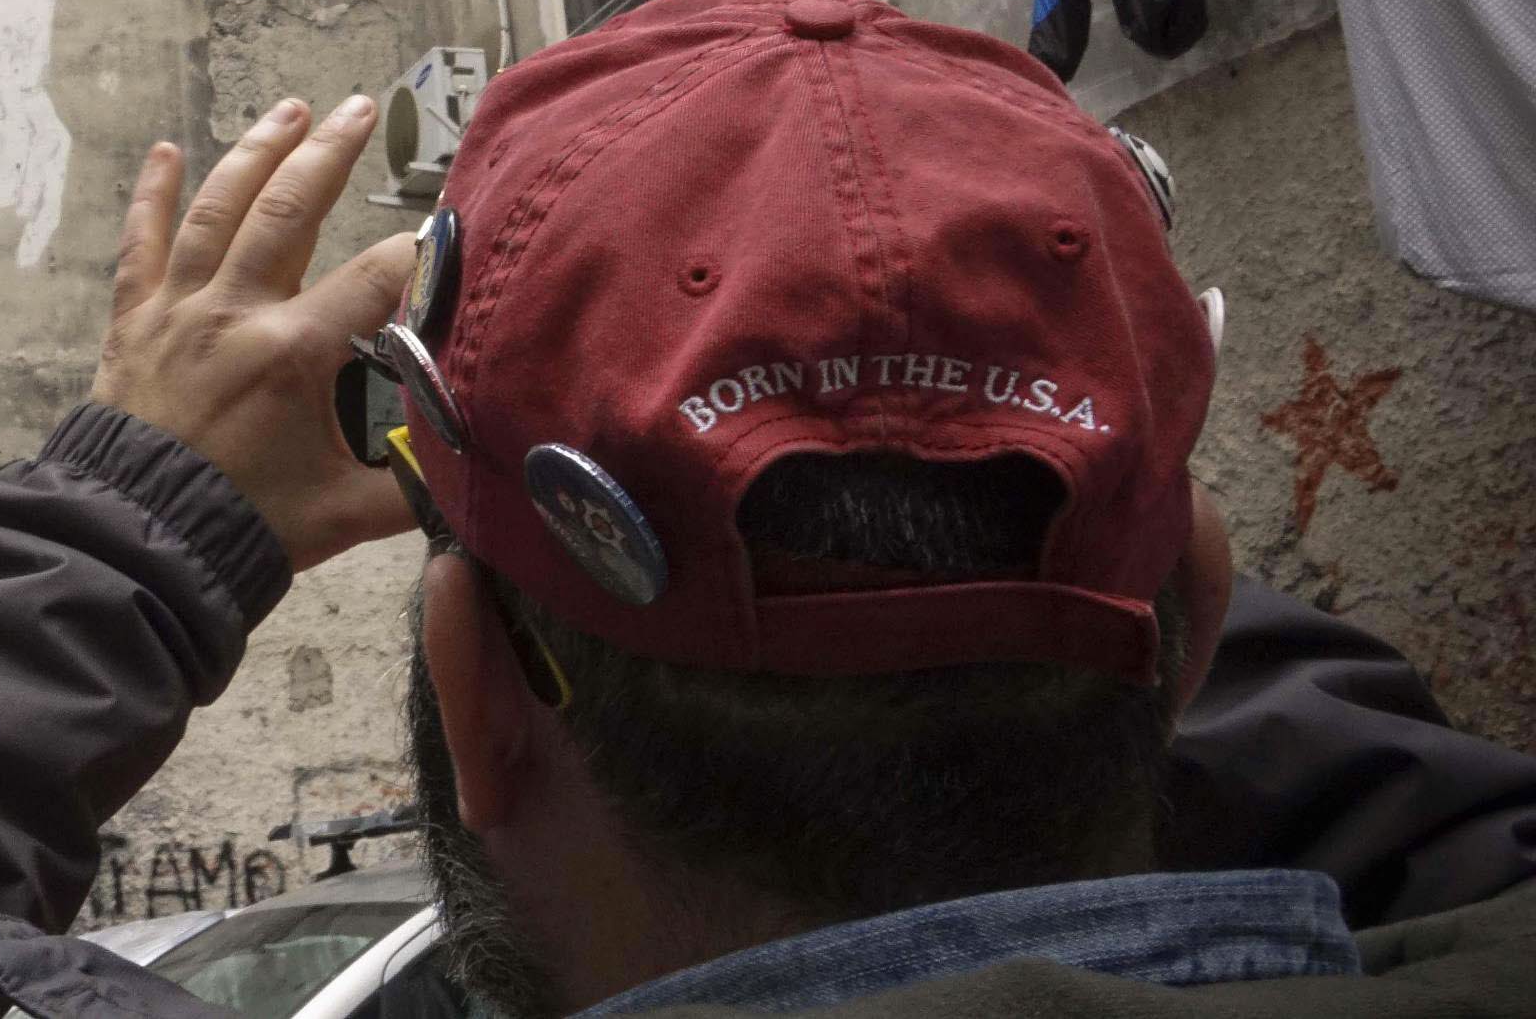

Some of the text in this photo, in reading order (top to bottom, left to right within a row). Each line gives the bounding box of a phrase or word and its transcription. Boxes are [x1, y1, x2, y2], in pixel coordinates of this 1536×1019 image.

[677, 353, 1112, 434] BORN IN THE U.S.A.
